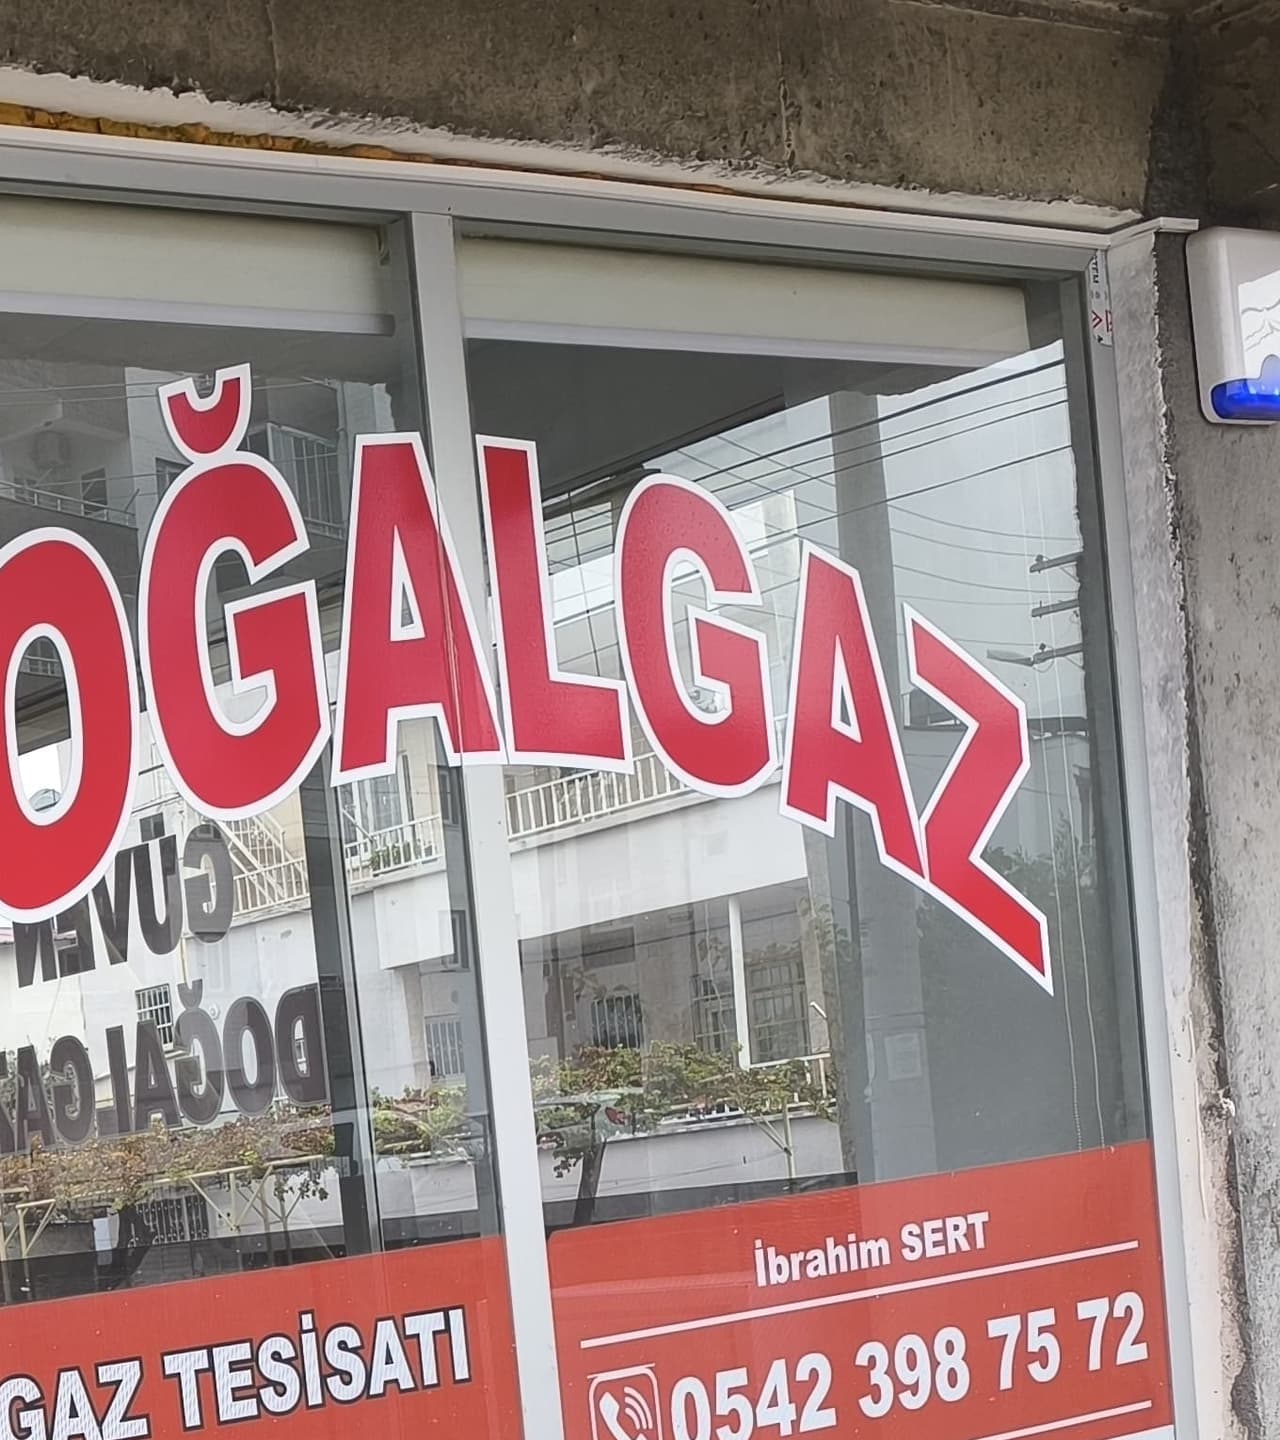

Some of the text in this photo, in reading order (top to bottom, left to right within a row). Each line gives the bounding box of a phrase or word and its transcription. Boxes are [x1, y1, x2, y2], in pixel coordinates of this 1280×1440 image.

[753, 1211, 991, 1289] İbrahim SERT
[162, 1307, 474, 1433] TESİSATI
[854, 1326, 971, 1420] 398
[987, 1306, 1063, 1391] 75
[1077, 1290, 1150, 1372] 72
